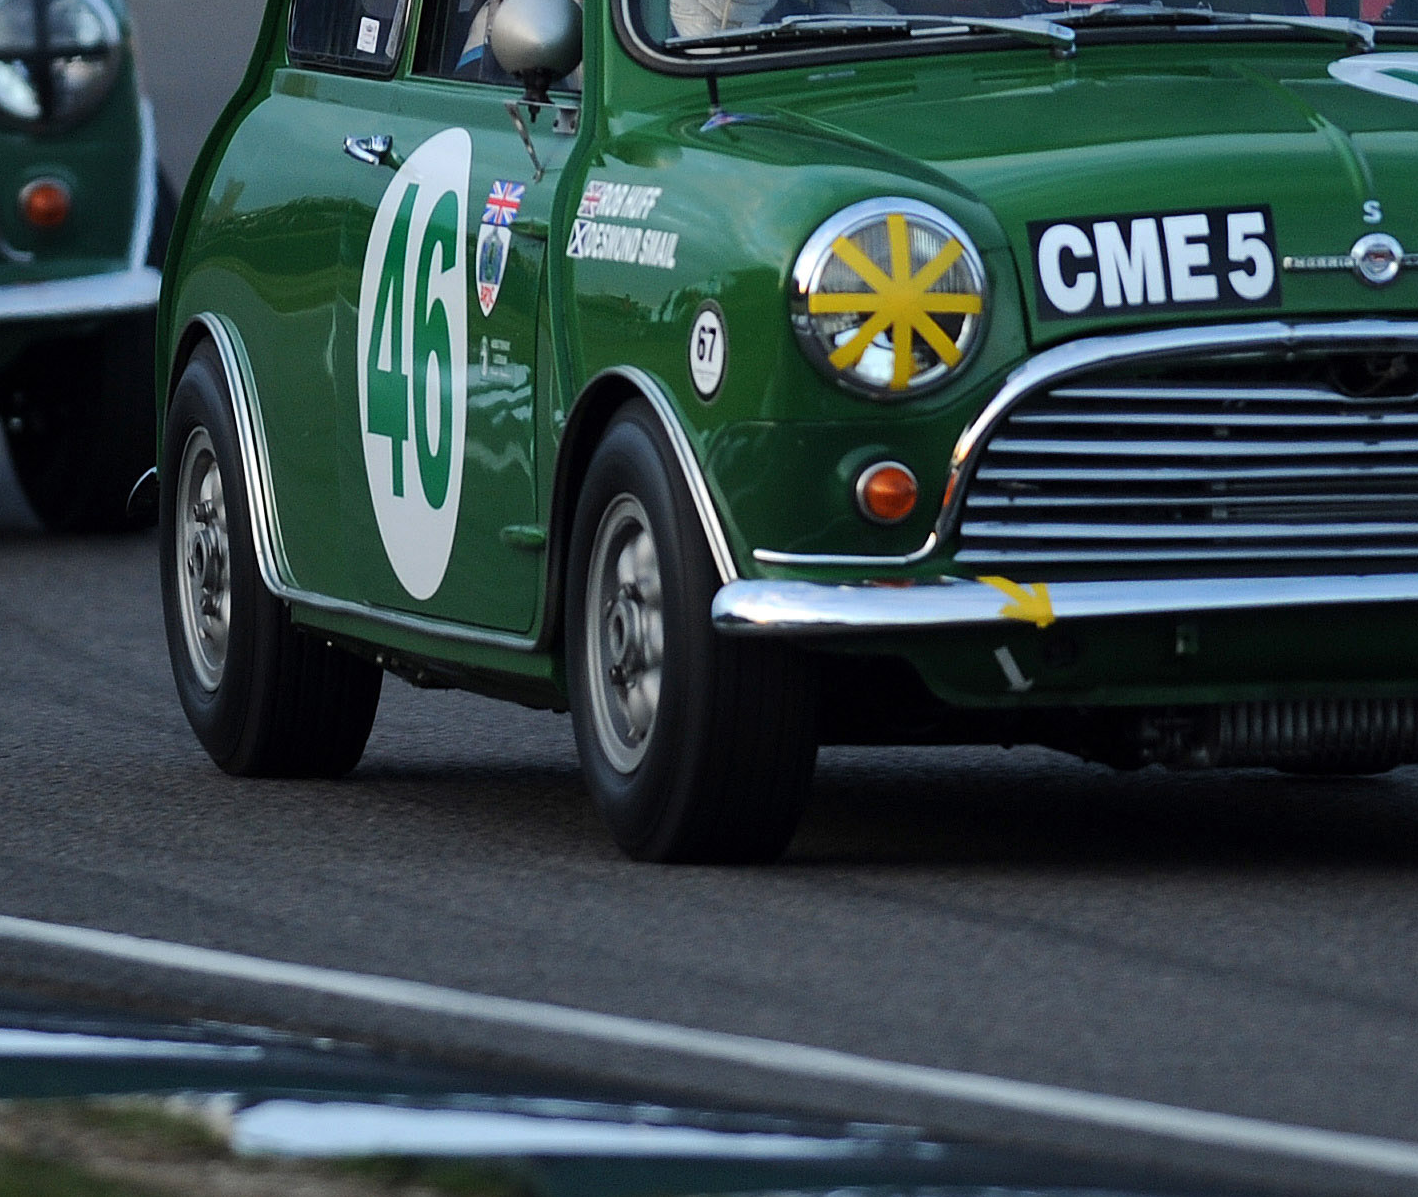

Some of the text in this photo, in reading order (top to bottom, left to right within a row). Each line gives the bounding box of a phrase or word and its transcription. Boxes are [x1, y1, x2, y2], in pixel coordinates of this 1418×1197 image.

[1363, 200, 1383, 224] S
[1038, 211, 1275, 314] CME 5
[367, 182, 459, 510] 46
[697, 325, 717, 362] 67
